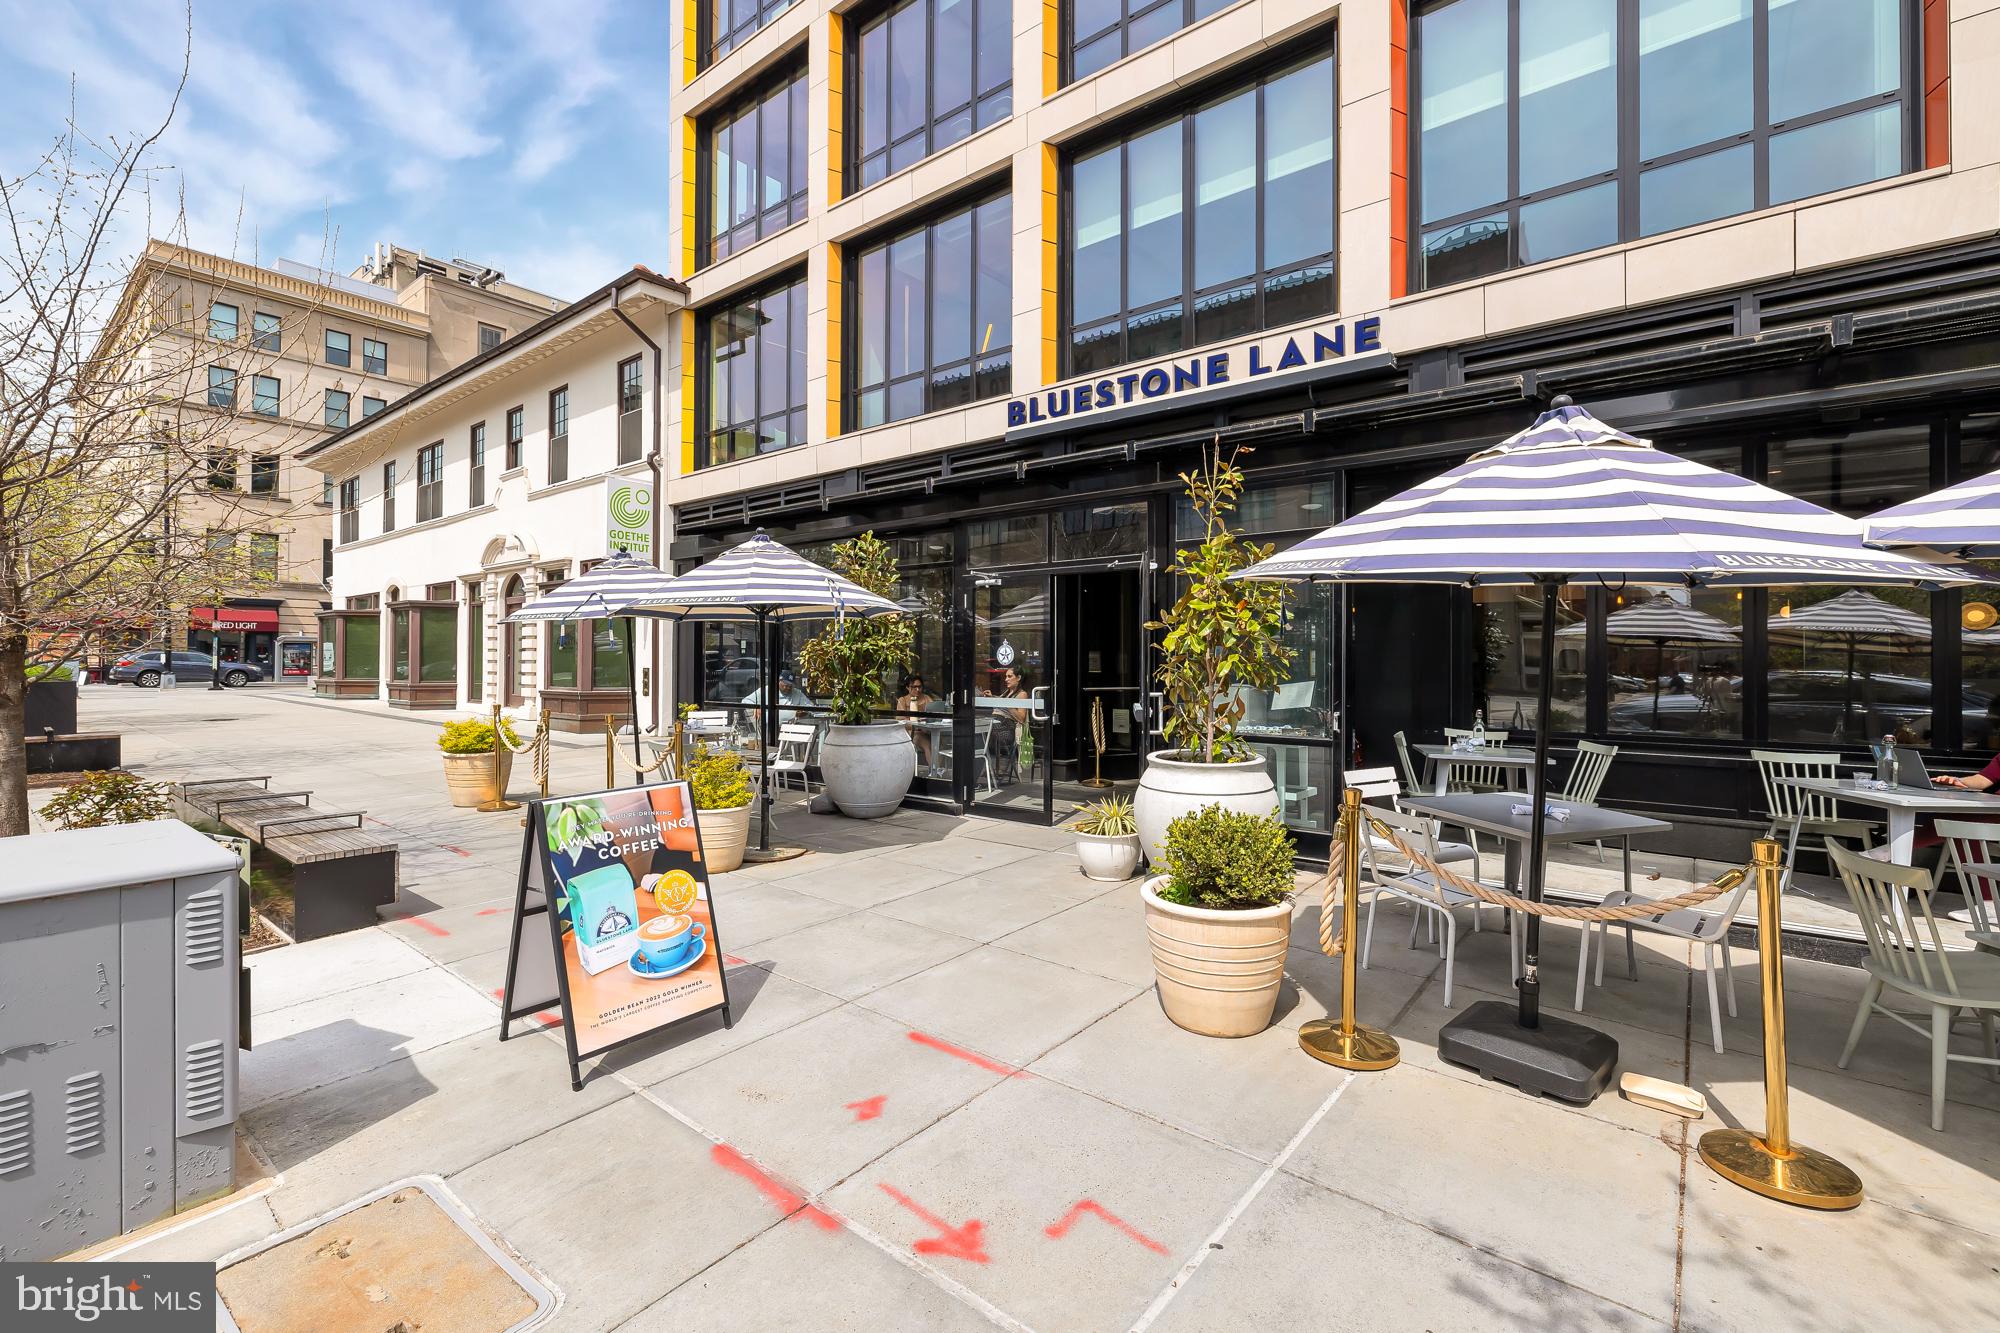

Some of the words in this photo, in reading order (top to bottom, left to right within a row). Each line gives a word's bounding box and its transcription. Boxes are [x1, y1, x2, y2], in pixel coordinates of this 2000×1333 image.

[1007, 352, 1229, 427] BLUESTONE
[1249, 316, 1381, 377] LANE
[609, 530, 650, 543] GOETHE
[609, 540, 650, 553] INSTITUT
[1715, 554, 1879, 572] BLUESTONE
[1886, 564, 1980, 579] LANE
[639, 597, 705, 605] BLUESTONE
[510, 612, 558, 620] BLUESTONE
[235, 622, 258, 630] LIGHT
[558, 817, 688, 851] AWARD-WINNING
[598, 838, 659, 859] COFFEE
[598, 1006, 626, 1019] GOLDEN
[627, 999, 644, 1010] BEAN
[646, 994, 662, 1003] 2022
[662, 988, 680, 997] GOLD
[680, 980, 703, 990] WINNER
[623, 1007, 644, 1018] LARGEST
